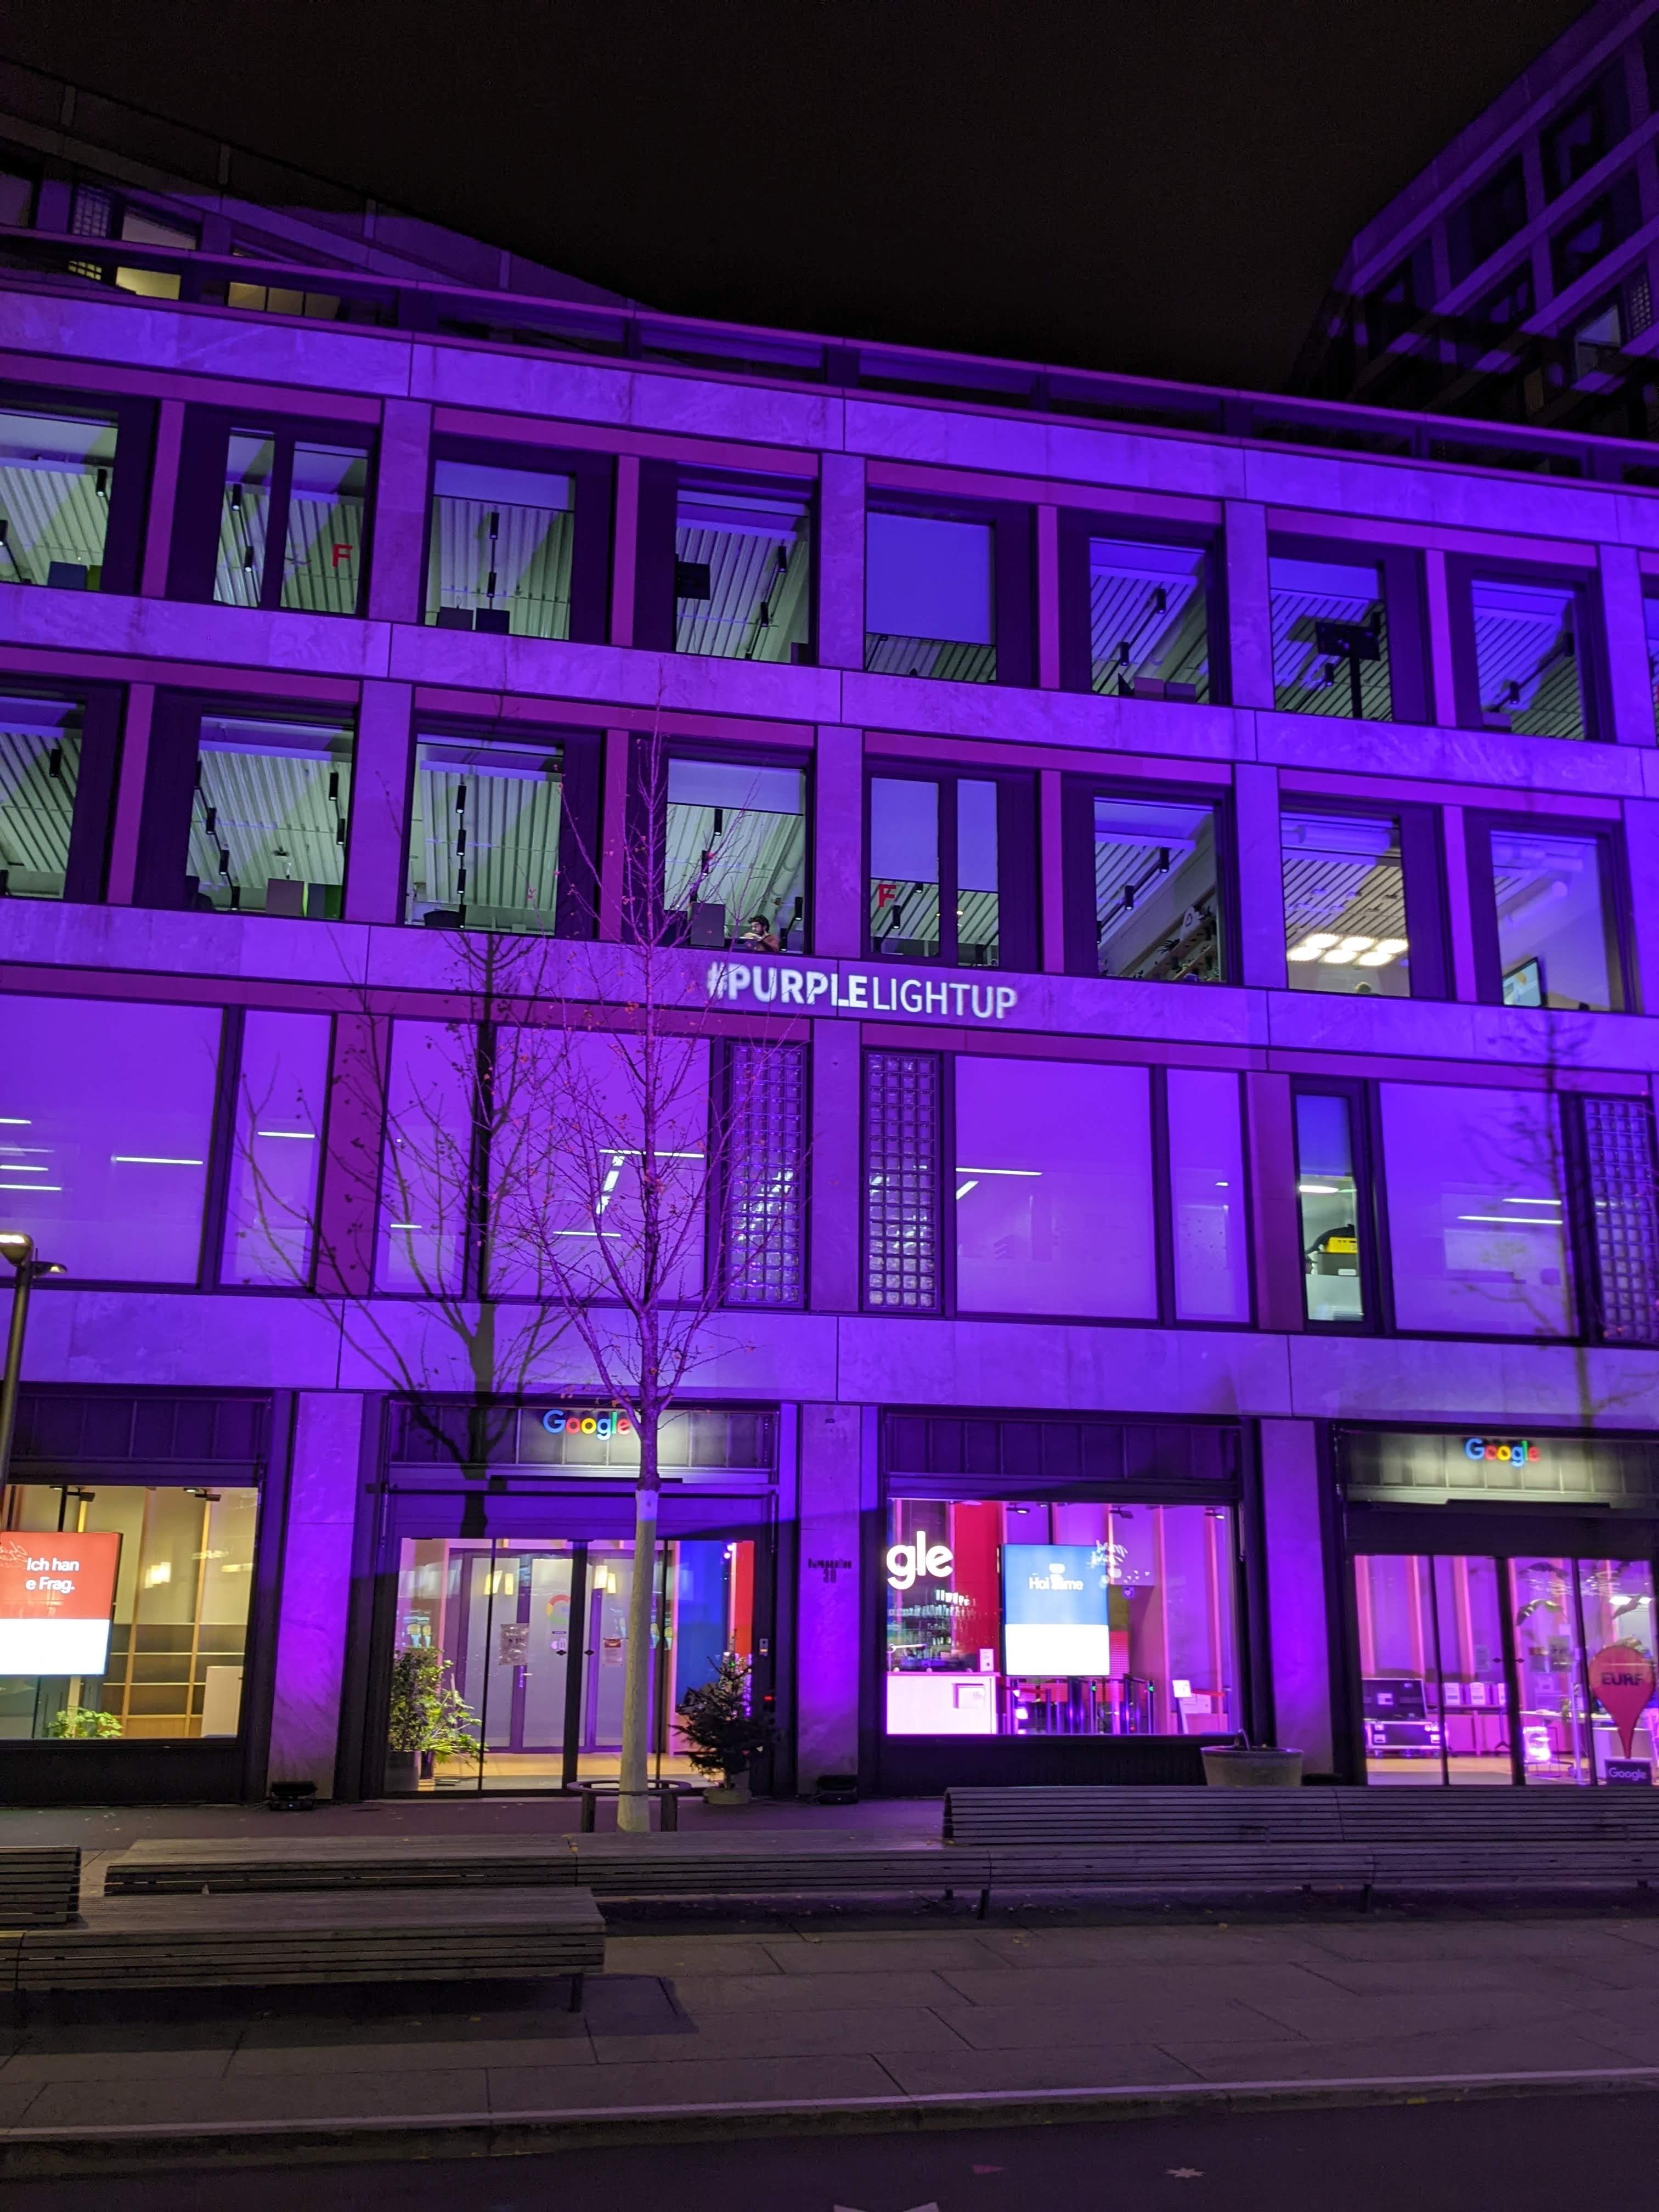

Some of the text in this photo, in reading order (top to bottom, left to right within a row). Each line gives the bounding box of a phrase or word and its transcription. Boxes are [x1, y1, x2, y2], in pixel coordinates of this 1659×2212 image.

[332, 543, 352, 568] F
[878, 884, 896, 908] F
[707, 961, 1018, 1019] #PURPLELIGHTUP
[543, 1409, 630, 1441] Google
[1465, 1437, 1541, 1467] Google
[26, 1557, 80, 1571] Ich han
[25, 1576, 76, 1594] e Frag.
[1608, 1767, 1647, 1781] Google
